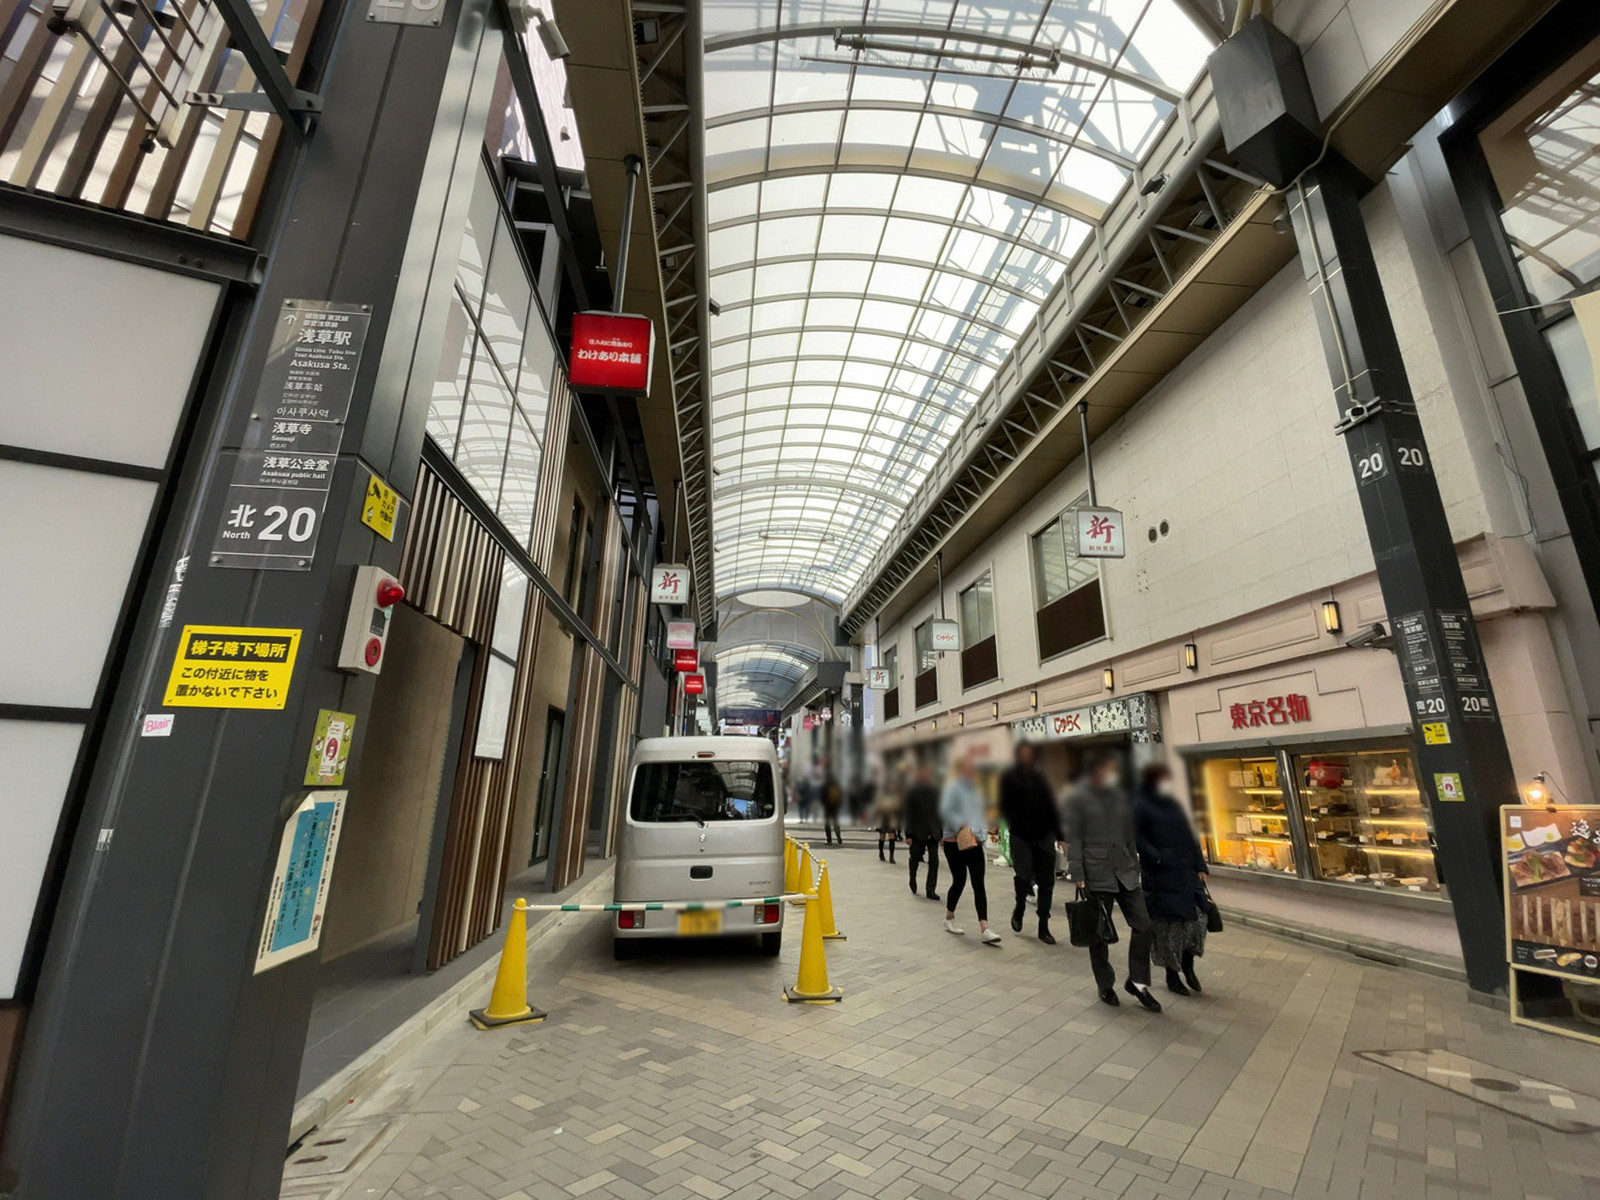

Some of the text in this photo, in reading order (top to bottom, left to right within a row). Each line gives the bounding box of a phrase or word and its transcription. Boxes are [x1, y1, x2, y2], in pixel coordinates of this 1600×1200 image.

[298, 328, 352, 345] 浅草駅
[290, 359, 350, 370] Asakusa Sta.
[272, 422, 312, 435] 浅草寺
[263, 457, 330, 472] 浅草公会堂
[1398, 447, 1424, 466] 20
[1359, 453, 1383, 478] 20
[227, 504, 257, 528] 北
[257, 505, 317, 542] 20
[222, 530, 251, 539] North
[1086, 514, 1115, 543] 新
[657, 571, 681, 593] 新
[190, 640, 287, 658] 梯子降下場所
[181, 667, 269, 681] この付近に物を
[175, 684, 278, 699] 置かないで下さい
[1229, 693, 1312, 730] 東京名物
[1427, 698, 1446, 714] 20
[1462, 697, 1480, 712] 20
